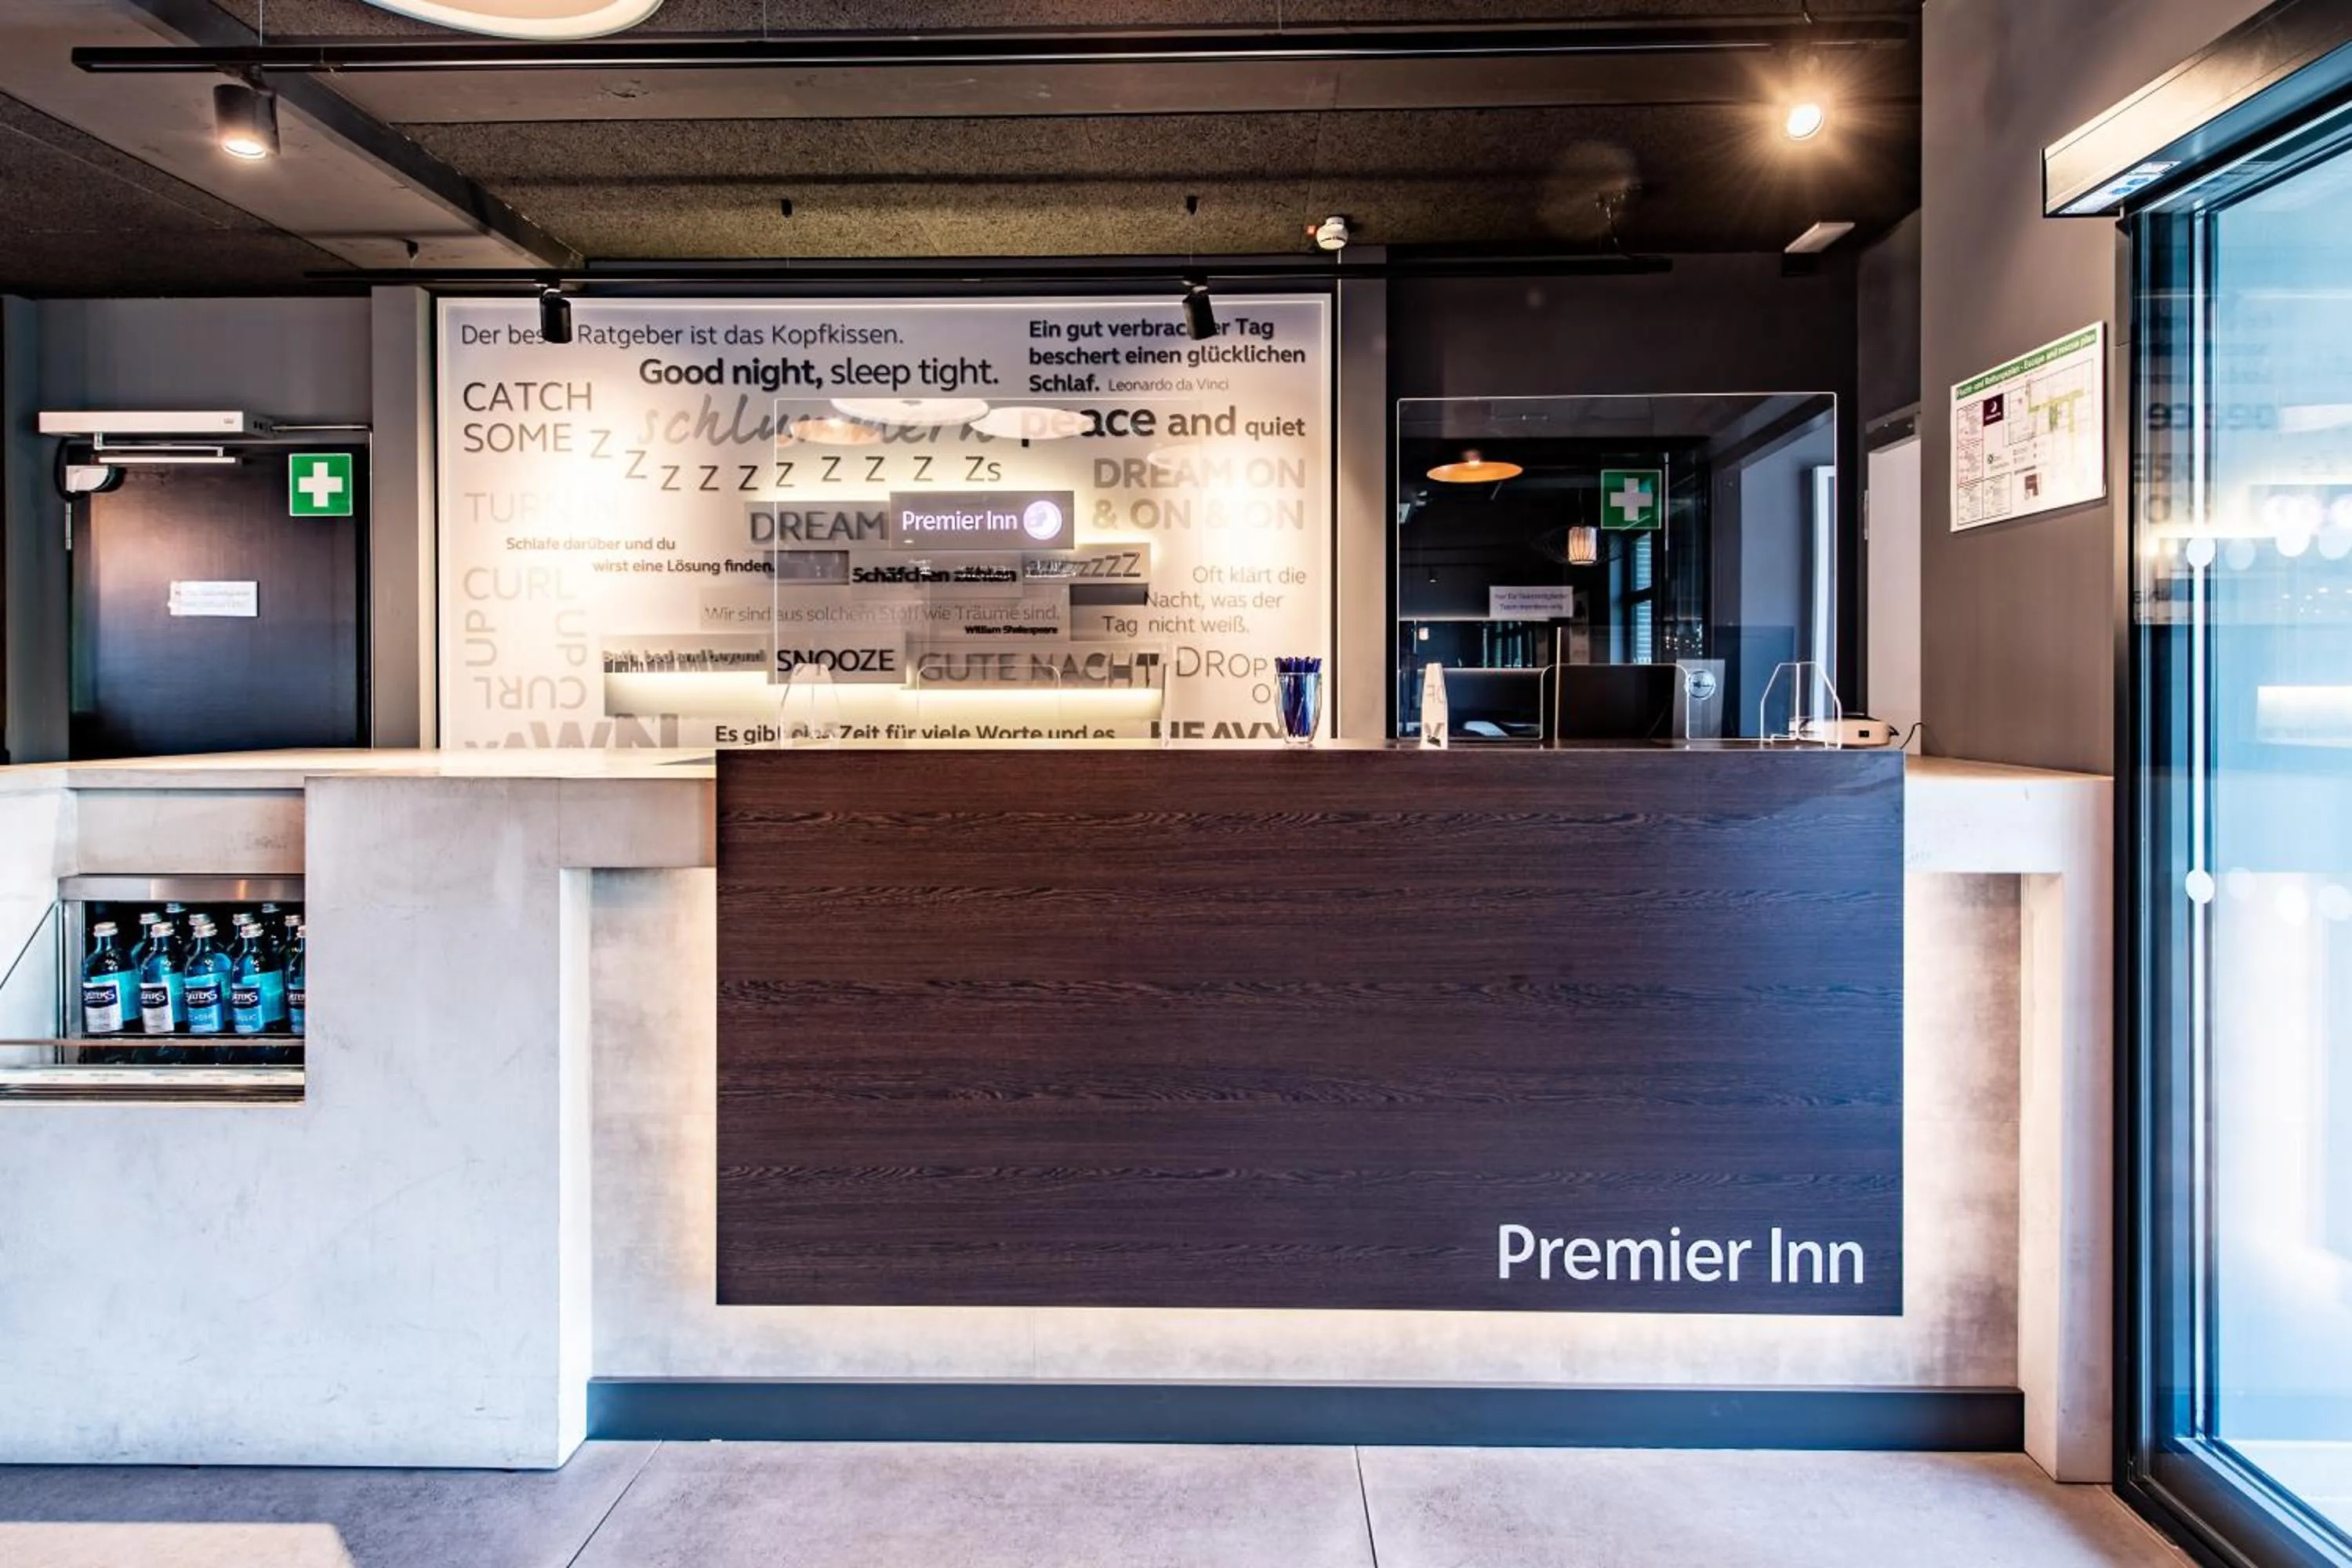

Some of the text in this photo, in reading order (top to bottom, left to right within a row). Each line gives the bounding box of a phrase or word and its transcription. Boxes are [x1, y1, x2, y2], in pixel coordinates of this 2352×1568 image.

[462, 322, 904, 350] Der bes Ratgeber ist das Kopfkissen.
[1029, 318, 1275, 343] Ein gut verbracer Tag
[1029, 344, 1306, 368] beschert einen glücklichen
[640, 357, 1000, 392] Good night, sleep tight.
[1029, 373, 1229, 393] Schlaf. Leonardo da Vinci
[463, 381, 593, 412] CATCH
[1168, 405, 1237, 437] and
[1245, 416, 1306, 441] quiet
[463, 422, 1002, 492] SOME Z Z Z Z Z Z Z Z Z Zs
[1092, 457, 1306, 489] DREAM ON
[750, 511, 889, 543] DREAM
[902, 509, 1018, 532] Premier Inn
[1092, 498, 1117, 530] &
[1130, 497, 1192, 530] ON
[1244, 498, 1305, 531] ON
[506, 536, 677, 551] Schlafe darüber und du
[593, 557, 776, 575] wirst eine Lösung finden.
[852, 566, 949, 583] Schäfchen
[1193, 565, 1307, 585] Oft klärt die
[462, 565, 578, 601] CURL
[705, 605, 735, 622] Wir
[739, 605, 772, 622] sind
[776, 608, 804, 622] aus
[807, 605, 876, 622] solchem
[924, 604, 950, 620] wie
[956, 604, 1018, 621] Träume
[1022, 604, 1061, 622] sind.
[1145, 591, 1283, 611] Nacht, was der
[463, 608, 499, 668] UP
[554, 609, 588, 668] UP
[964, 625, 1058, 637] William Shakespeare
[1102, 614, 1250, 636] Tag nicht weiß.
[776, 648, 895, 673] SNOOZE
[918, 652, 1160, 686] GUTE NACHT
[473, 674, 588, 711] CURL
[463, 713, 679, 749] WN
[715, 724, 739, 743] Es
[840, 724, 880, 739] Zeit
[884, 724, 916, 739] für
[921, 724, 971, 739] viele
[975, 724, 1044, 739] Worte
[1047, 724, 1088, 739] und
[1093, 728, 1116, 739] es
[1498, 1223, 1864, 1283] Premier Inn
